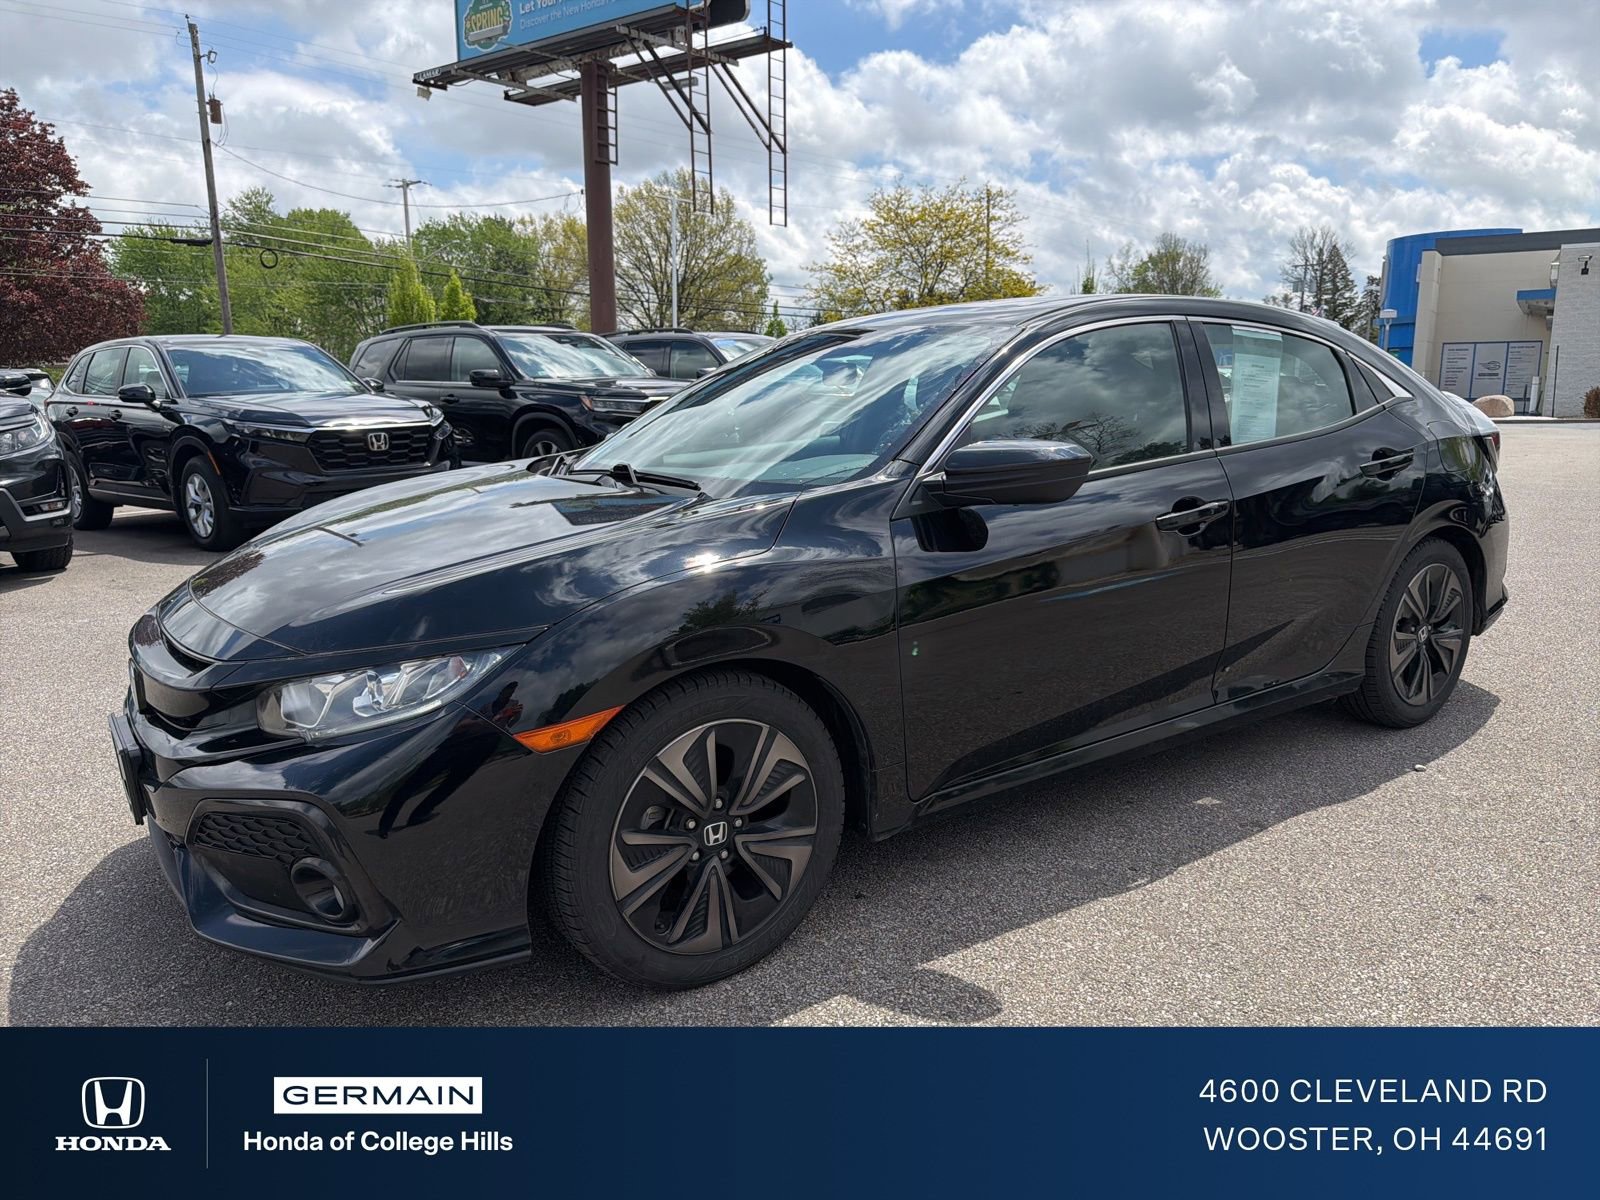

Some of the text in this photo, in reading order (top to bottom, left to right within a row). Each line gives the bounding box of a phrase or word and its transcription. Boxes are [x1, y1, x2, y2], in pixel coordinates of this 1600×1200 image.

[471, 7, 503, 31] SPRING
[519, 1, 535, 14] Let
[519, 15, 549, 29] Discover
[551, 11, 562, 20] the
[563, 6, 580, 16] New
